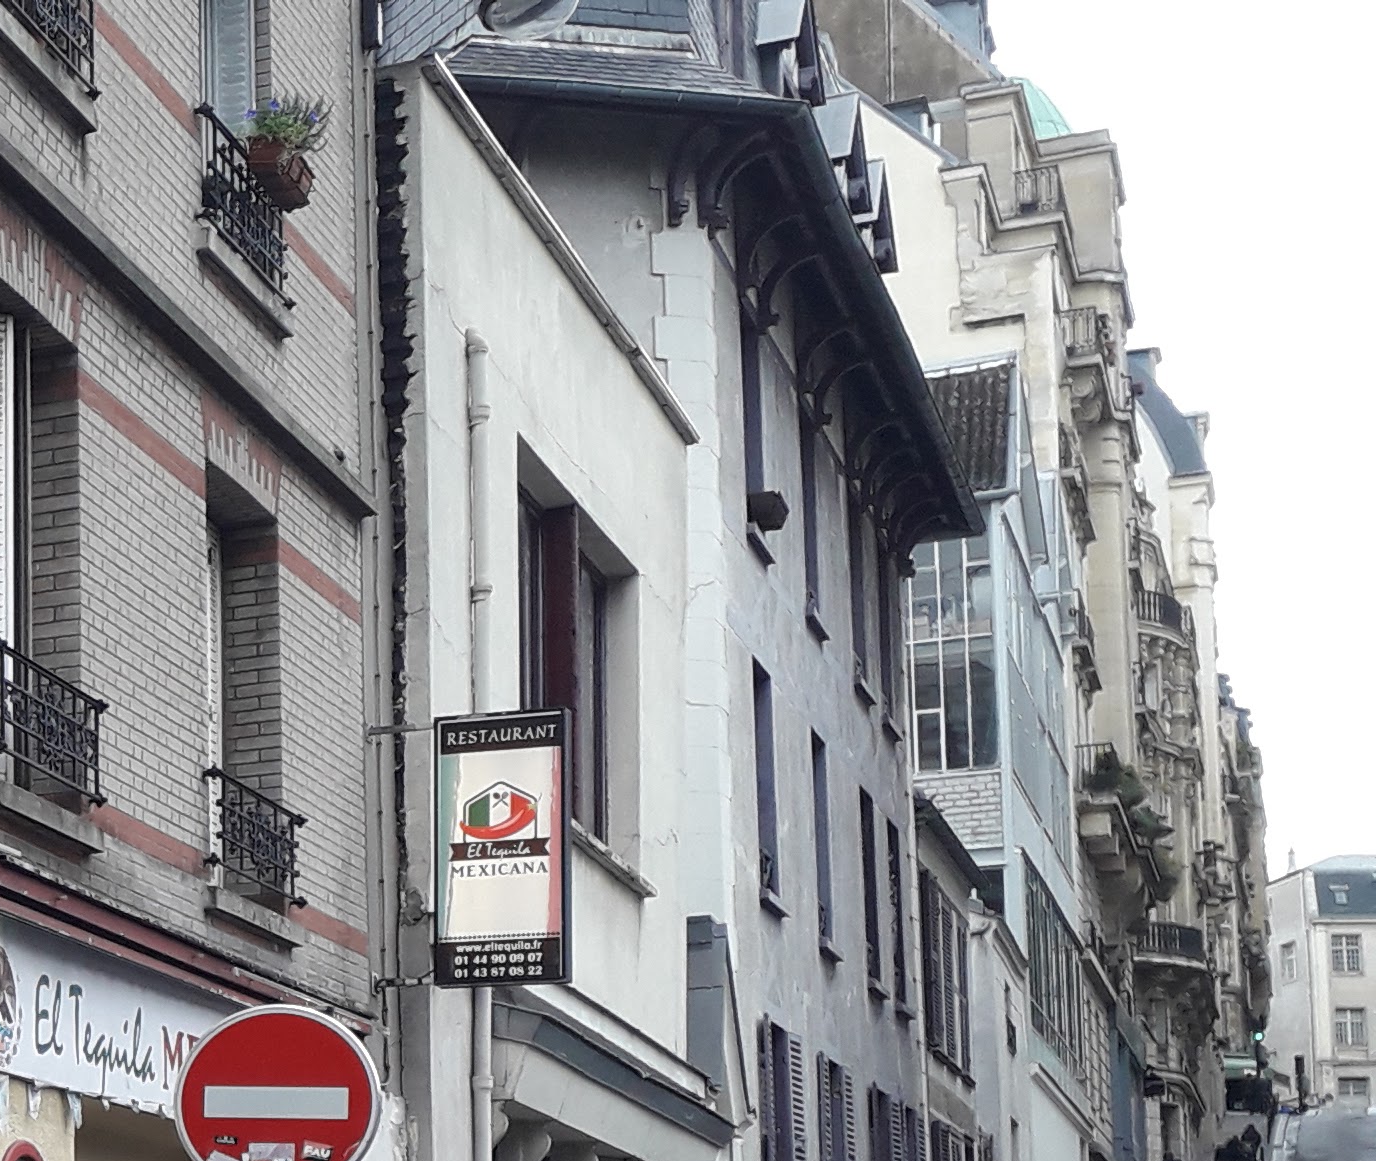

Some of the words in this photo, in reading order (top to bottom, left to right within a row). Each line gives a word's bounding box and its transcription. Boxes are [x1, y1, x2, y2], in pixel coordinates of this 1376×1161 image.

[447, 724, 557, 746] RESTAURANT
[467, 843, 481, 858] El
[486, 842, 531, 860] Tequila
[452, 861, 549, 878] MEXICANA
[34, 974, 64, 1058] El
[69, 984, 156, 1095] Tequila
